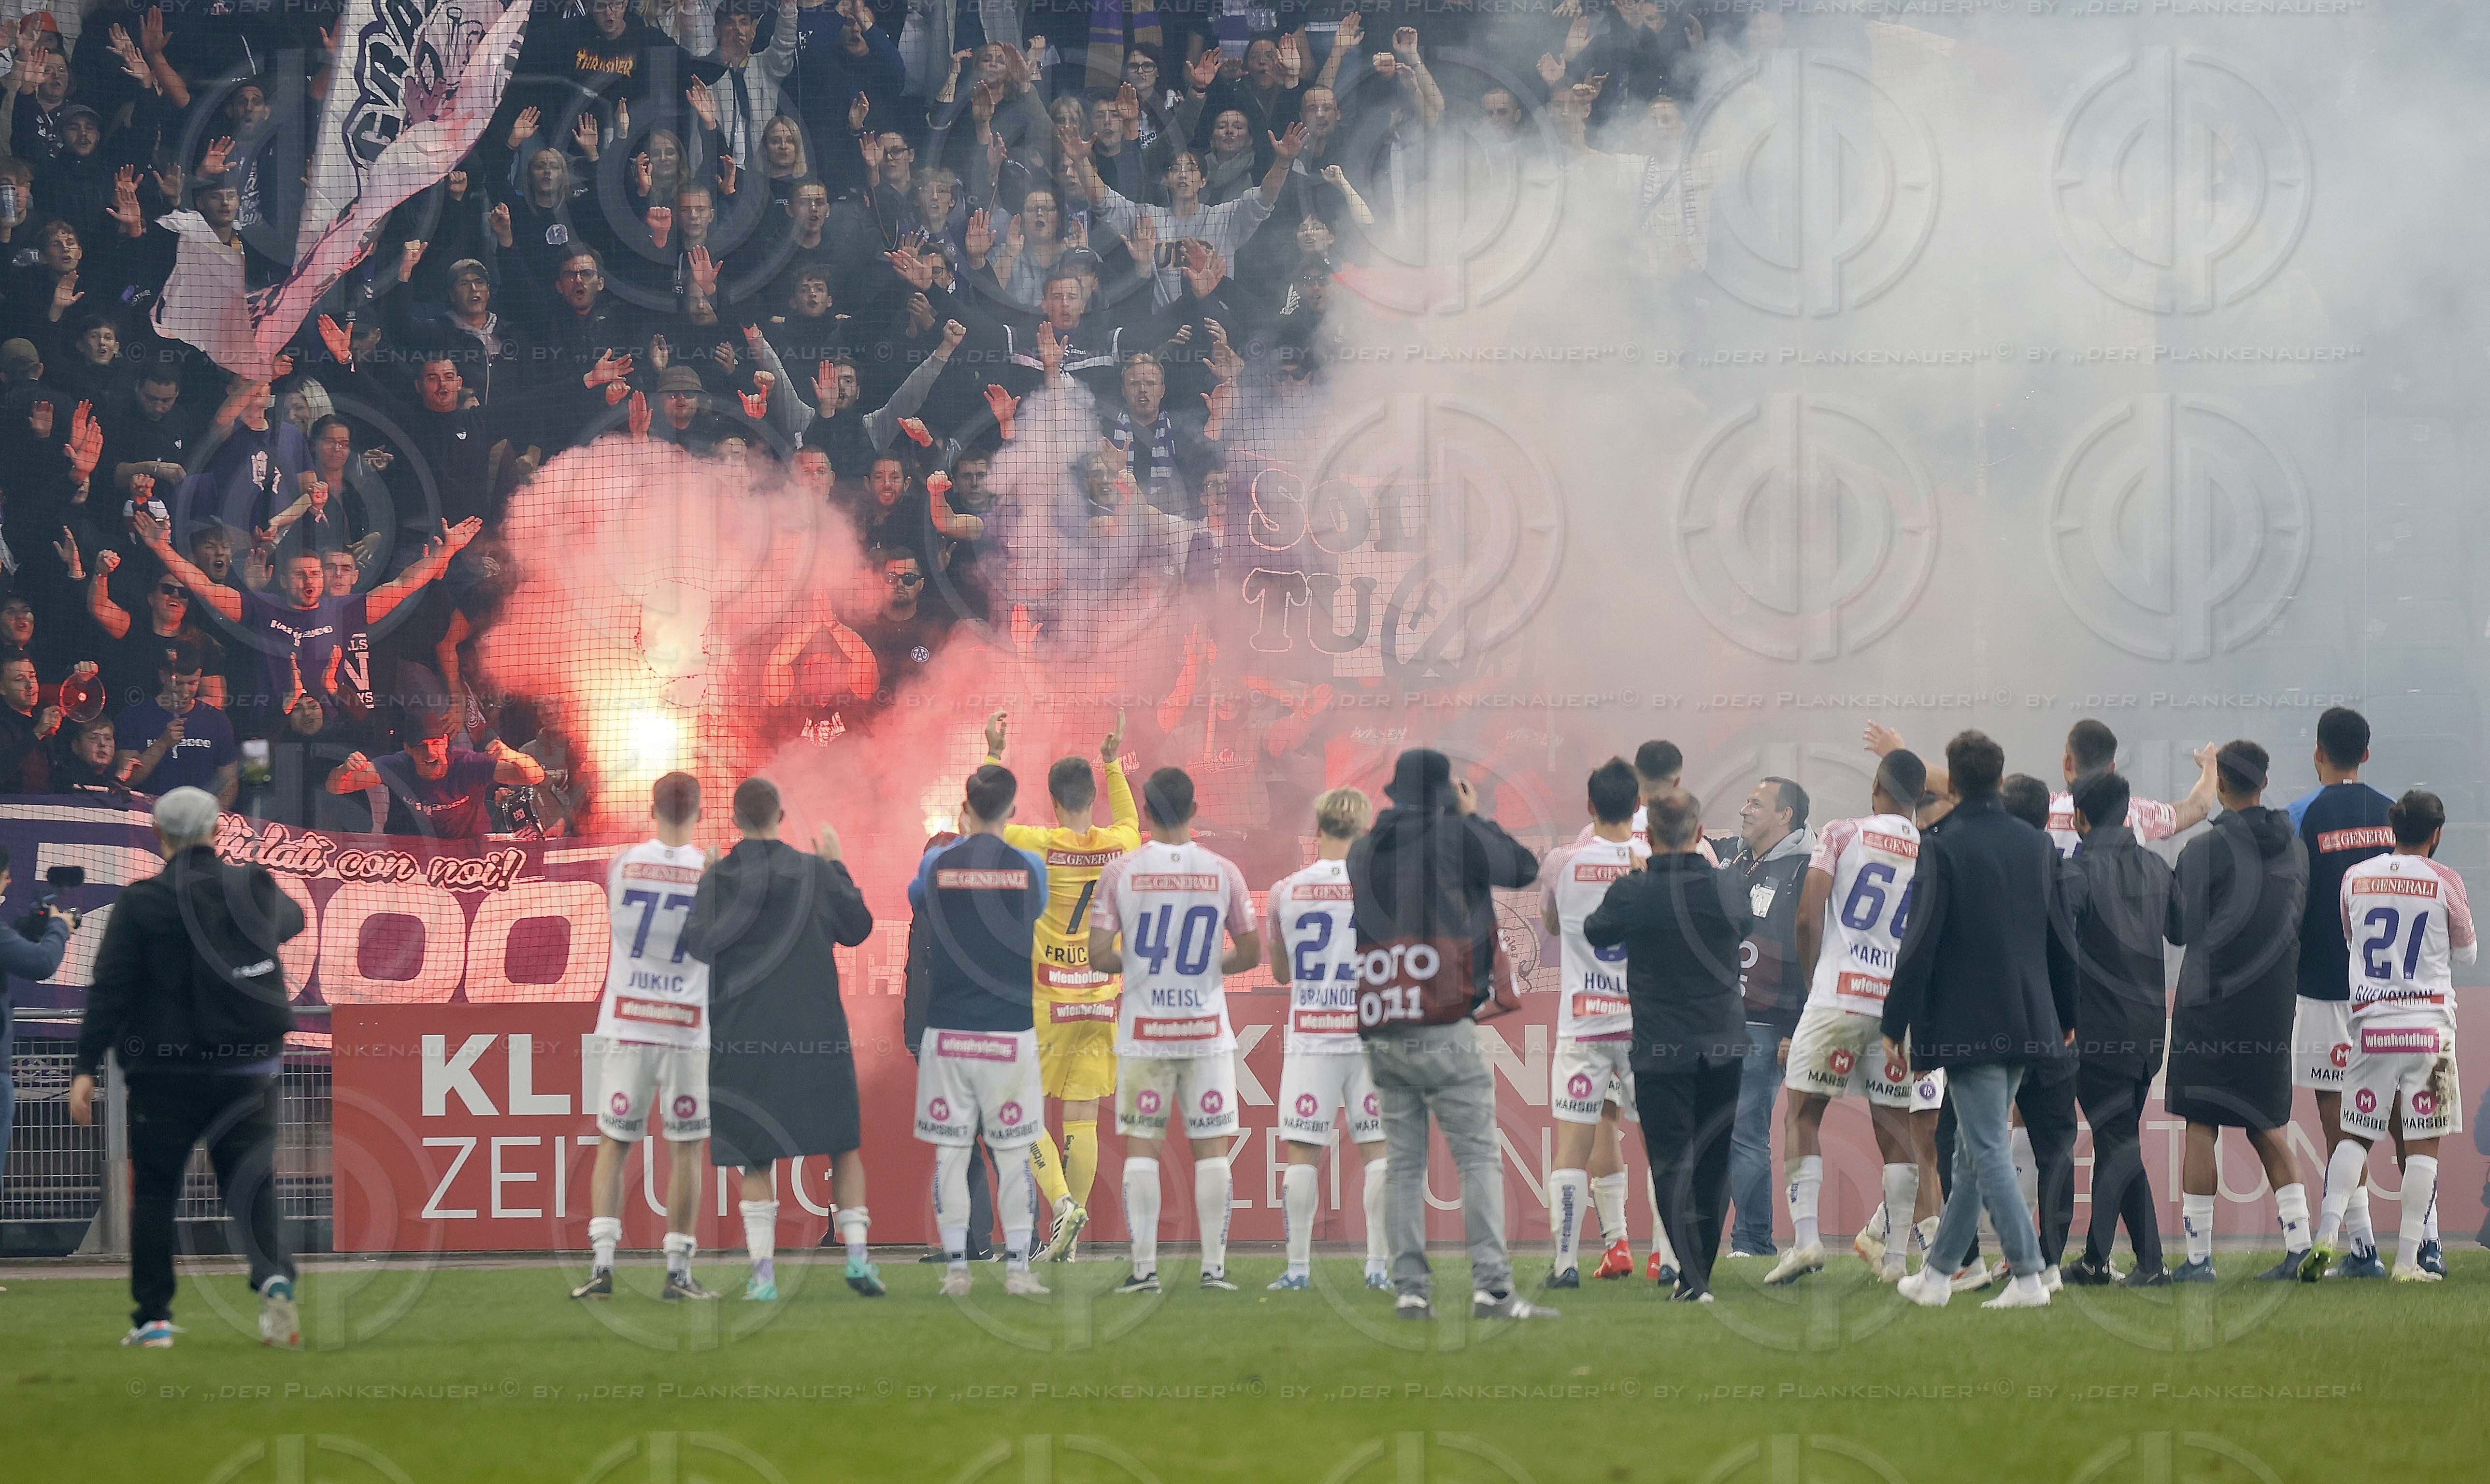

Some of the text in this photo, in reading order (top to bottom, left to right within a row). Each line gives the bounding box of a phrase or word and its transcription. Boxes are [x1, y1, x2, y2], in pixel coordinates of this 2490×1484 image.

[2340, 829, 2397, 845] GENERAL
[1884, 838, 1918, 858] GENE
[337, 850, 417, 883] con
[2371, 878, 2434, 896] GENERALI
[622, 890, 695, 963] 77
[1135, 905, 1218, 975] 40
[2363, 908, 2429, 979] 21
[1045, 944, 1087, 963] FRÜC
[1849, 941, 1893, 969] MARTI
[1151, 988, 1203, 1007] MEISL
[2365, 1032, 2435, 1049] wienholding
